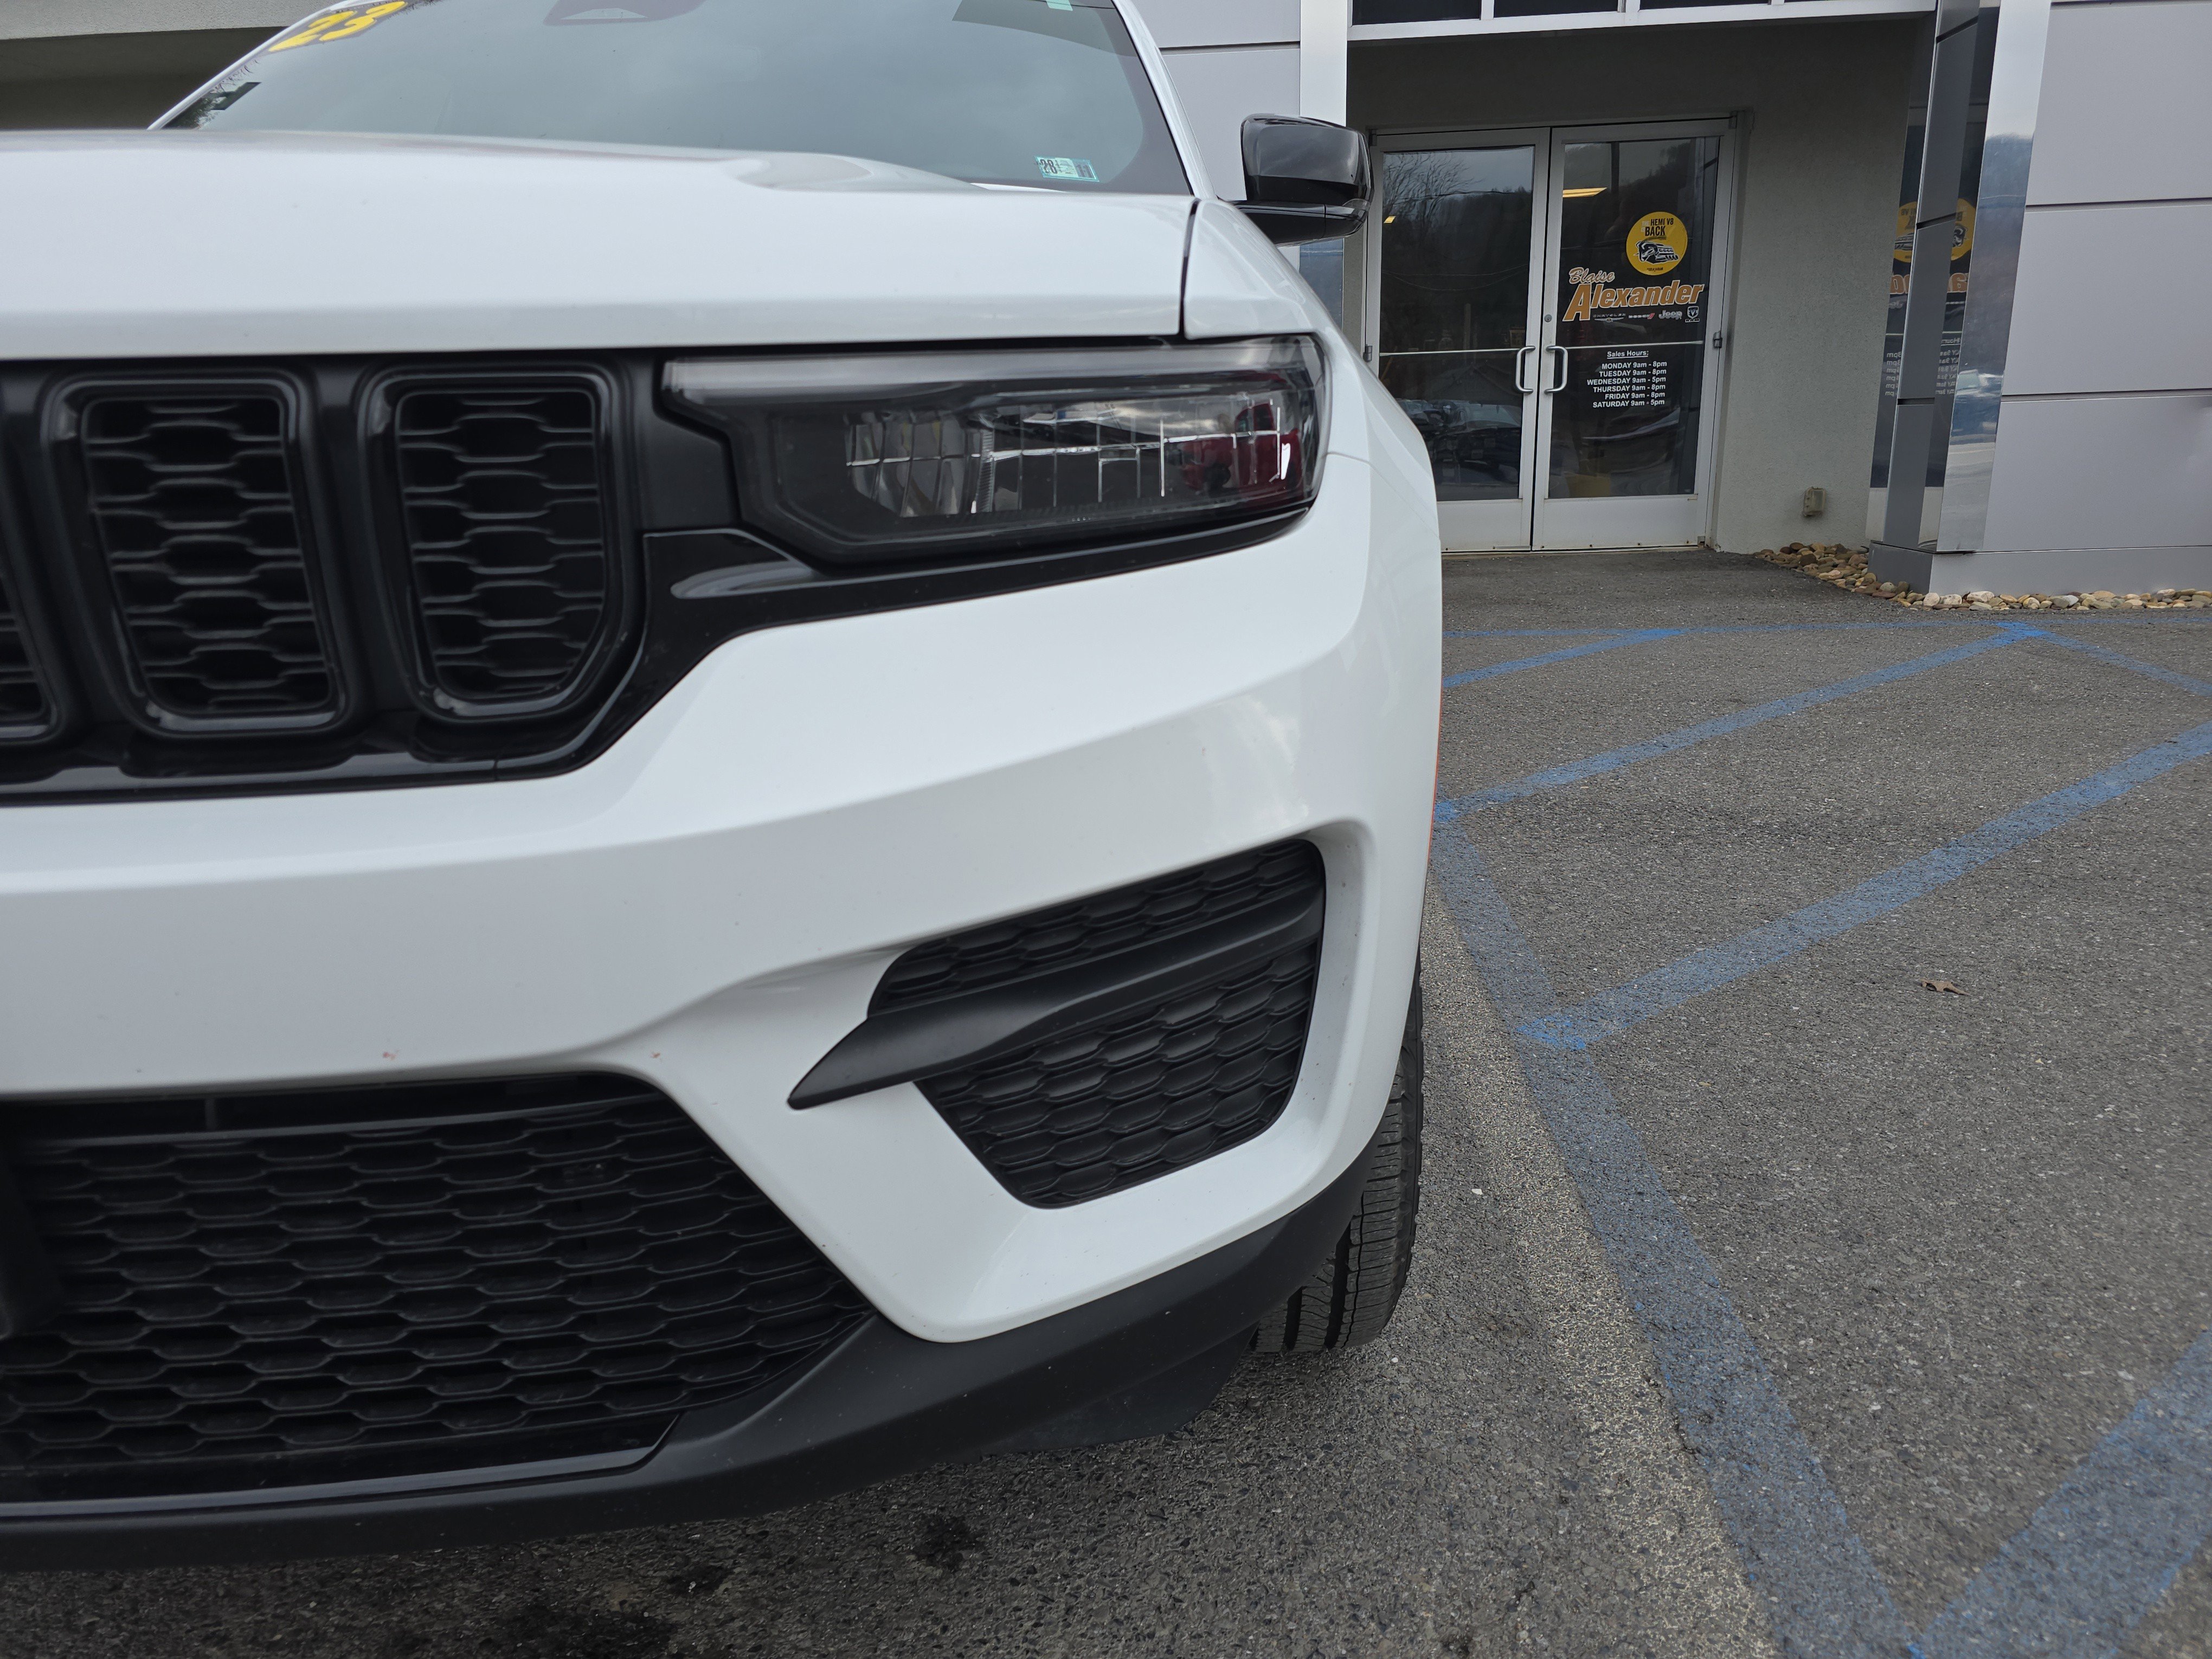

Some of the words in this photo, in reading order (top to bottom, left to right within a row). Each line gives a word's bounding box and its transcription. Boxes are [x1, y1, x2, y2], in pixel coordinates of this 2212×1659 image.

[1650, 218, 1665, 226] HEMI
[1645, 226, 1666, 236] BACK
[1568, 267, 1615, 285] Blaise
[1562, 280, 1705, 322] Alexander
[1658, 310, 1683, 320] Jeep
